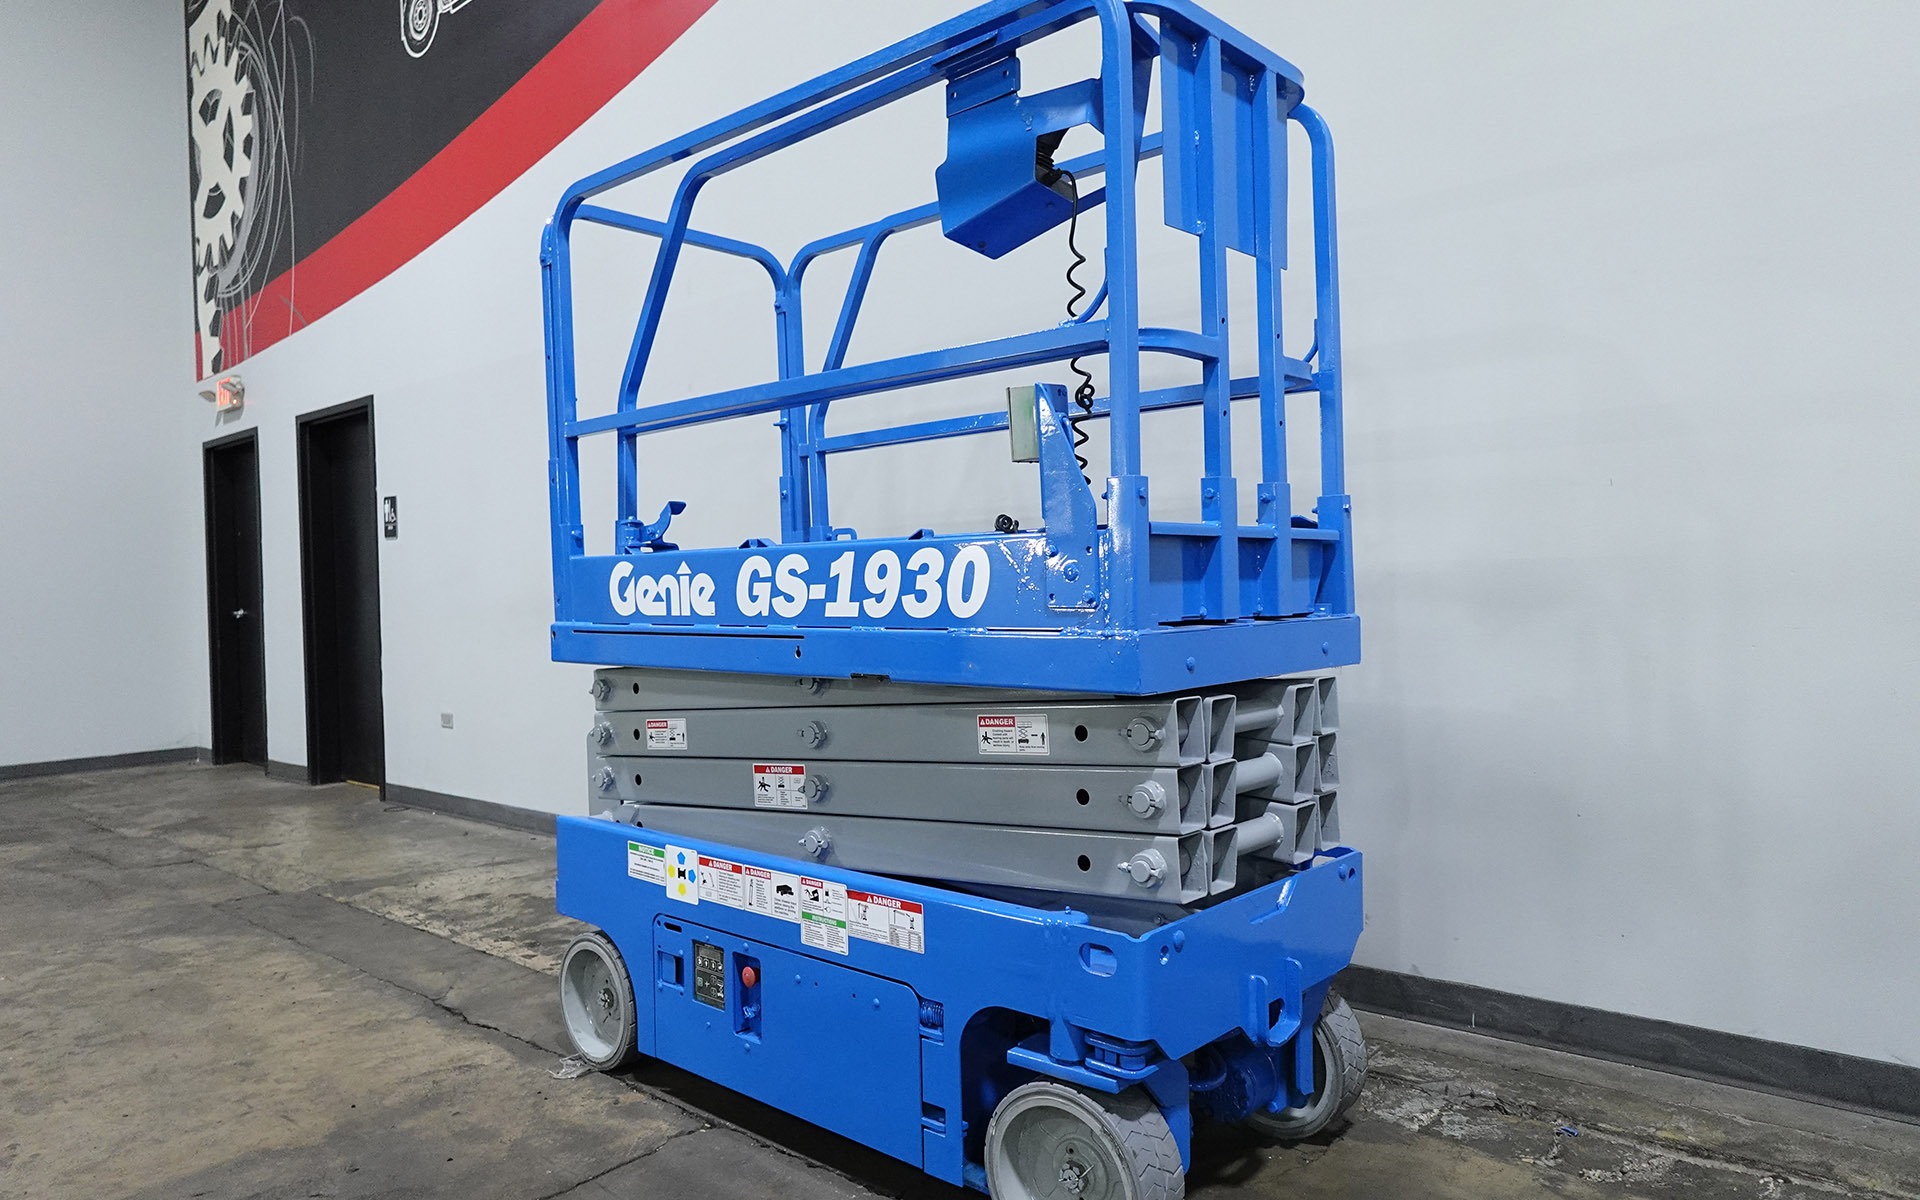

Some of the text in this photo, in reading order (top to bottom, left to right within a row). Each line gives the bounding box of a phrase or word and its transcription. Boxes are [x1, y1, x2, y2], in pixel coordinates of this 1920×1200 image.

[609, 545, 990, 618] Genie GS-1930
[770, 766, 793, 774] DANGER
[713, 860, 733, 872] DANGER
[750, 868, 771, 880] DANGER
[806, 879, 822, 888] DANGER
[873, 895, 901, 909] DANGER
